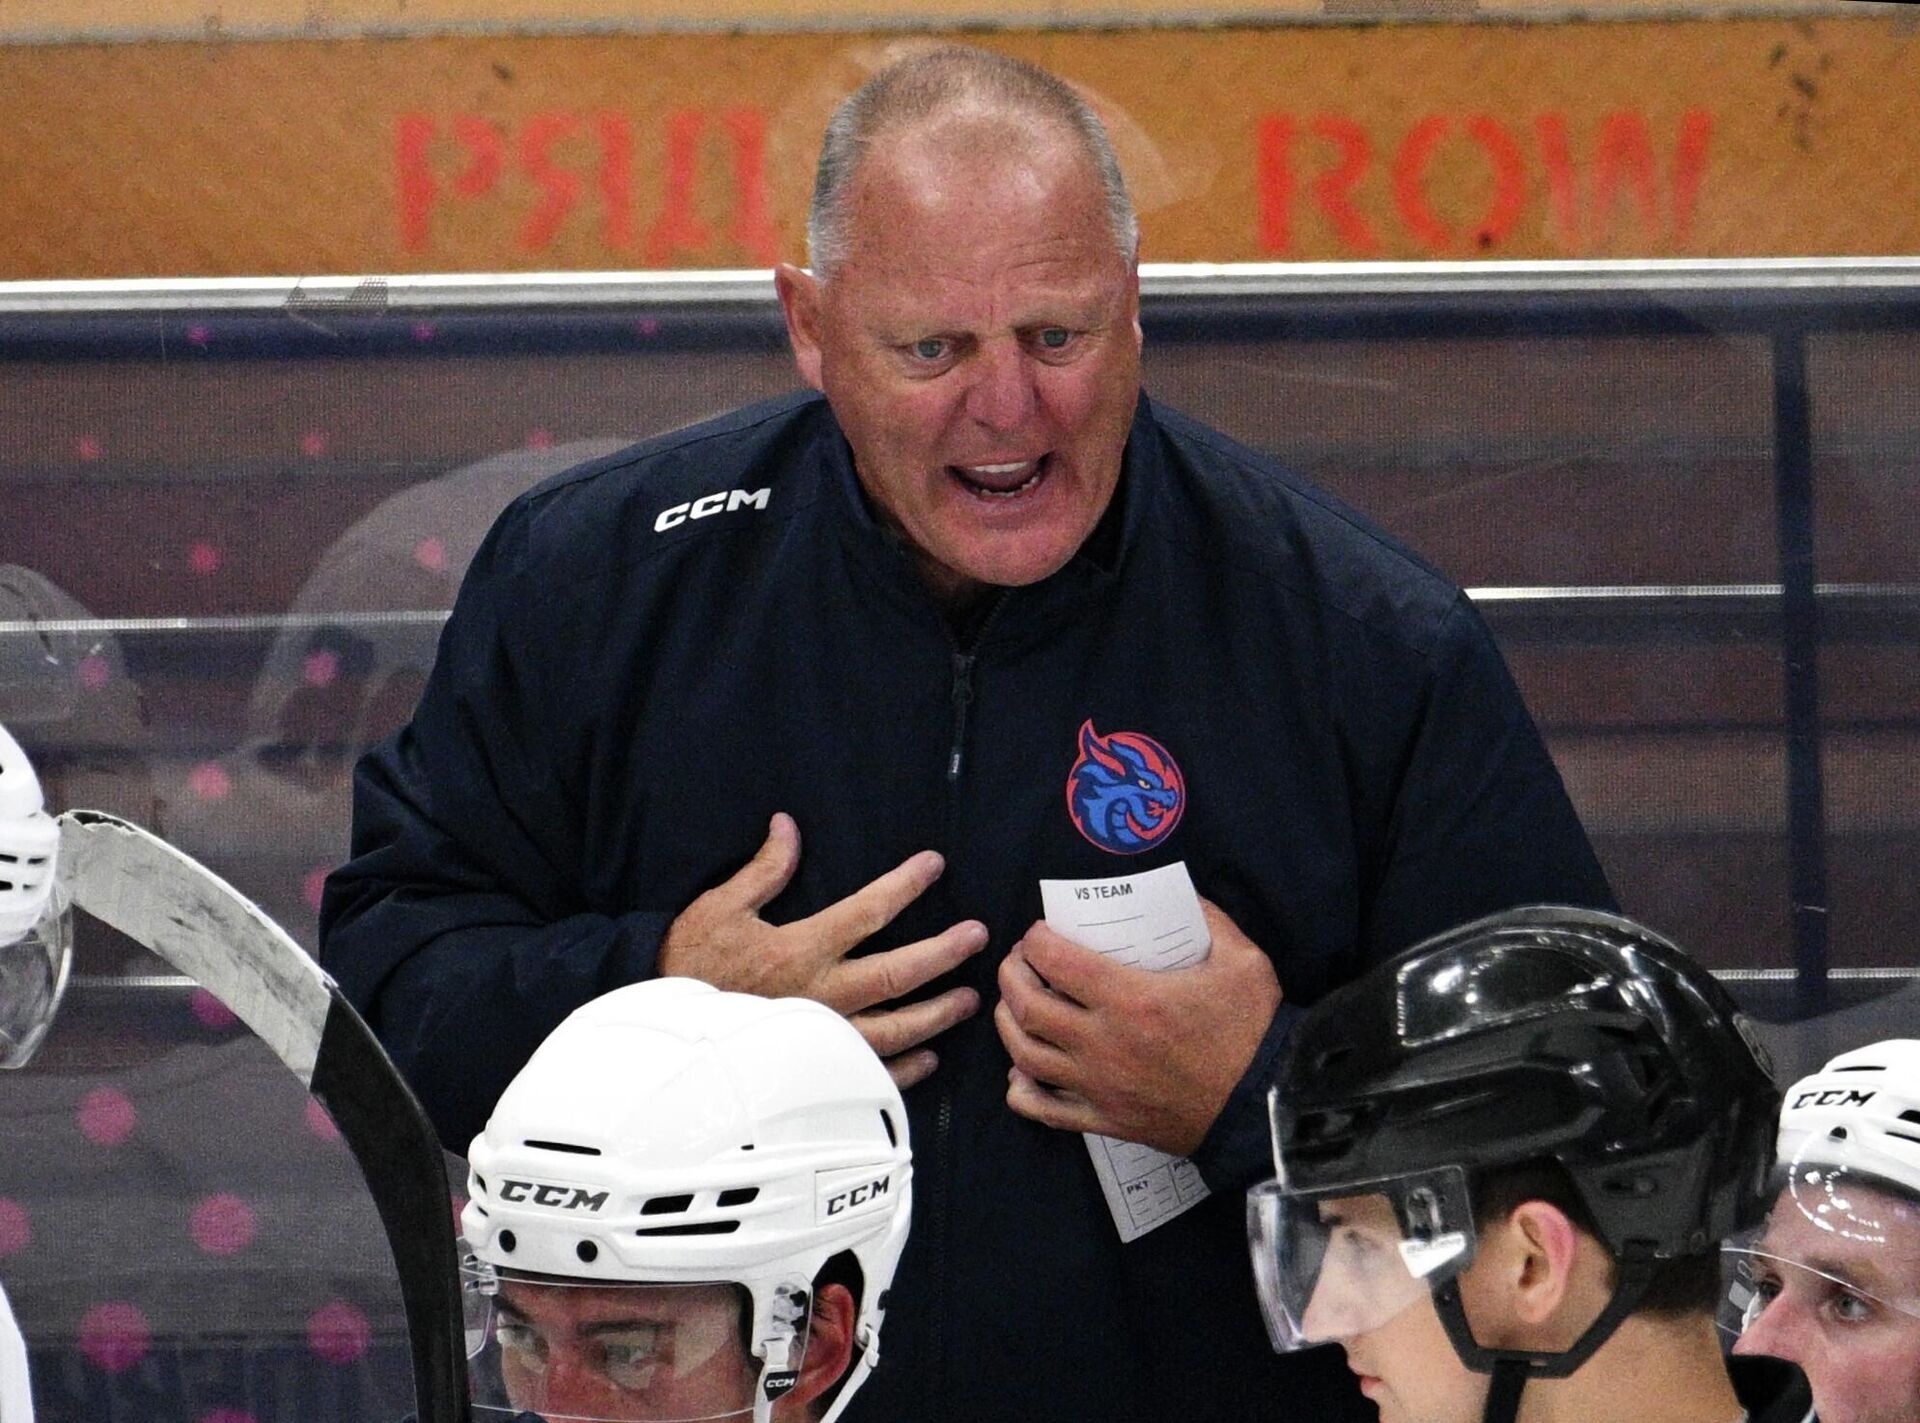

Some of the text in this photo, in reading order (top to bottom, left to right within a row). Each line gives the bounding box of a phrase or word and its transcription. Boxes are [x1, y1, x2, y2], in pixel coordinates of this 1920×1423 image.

[1257, 109, 1714, 254] ROW
[653, 487, 771, 533] CCM
[1074, 883, 1133, 900] VS TEAM
[1790, 1090, 1877, 1110] CCM
[499, 1179, 610, 1212] CCM
[827, 1175, 890, 1216] CCM
[766, 1378, 796, 1388] CCM
